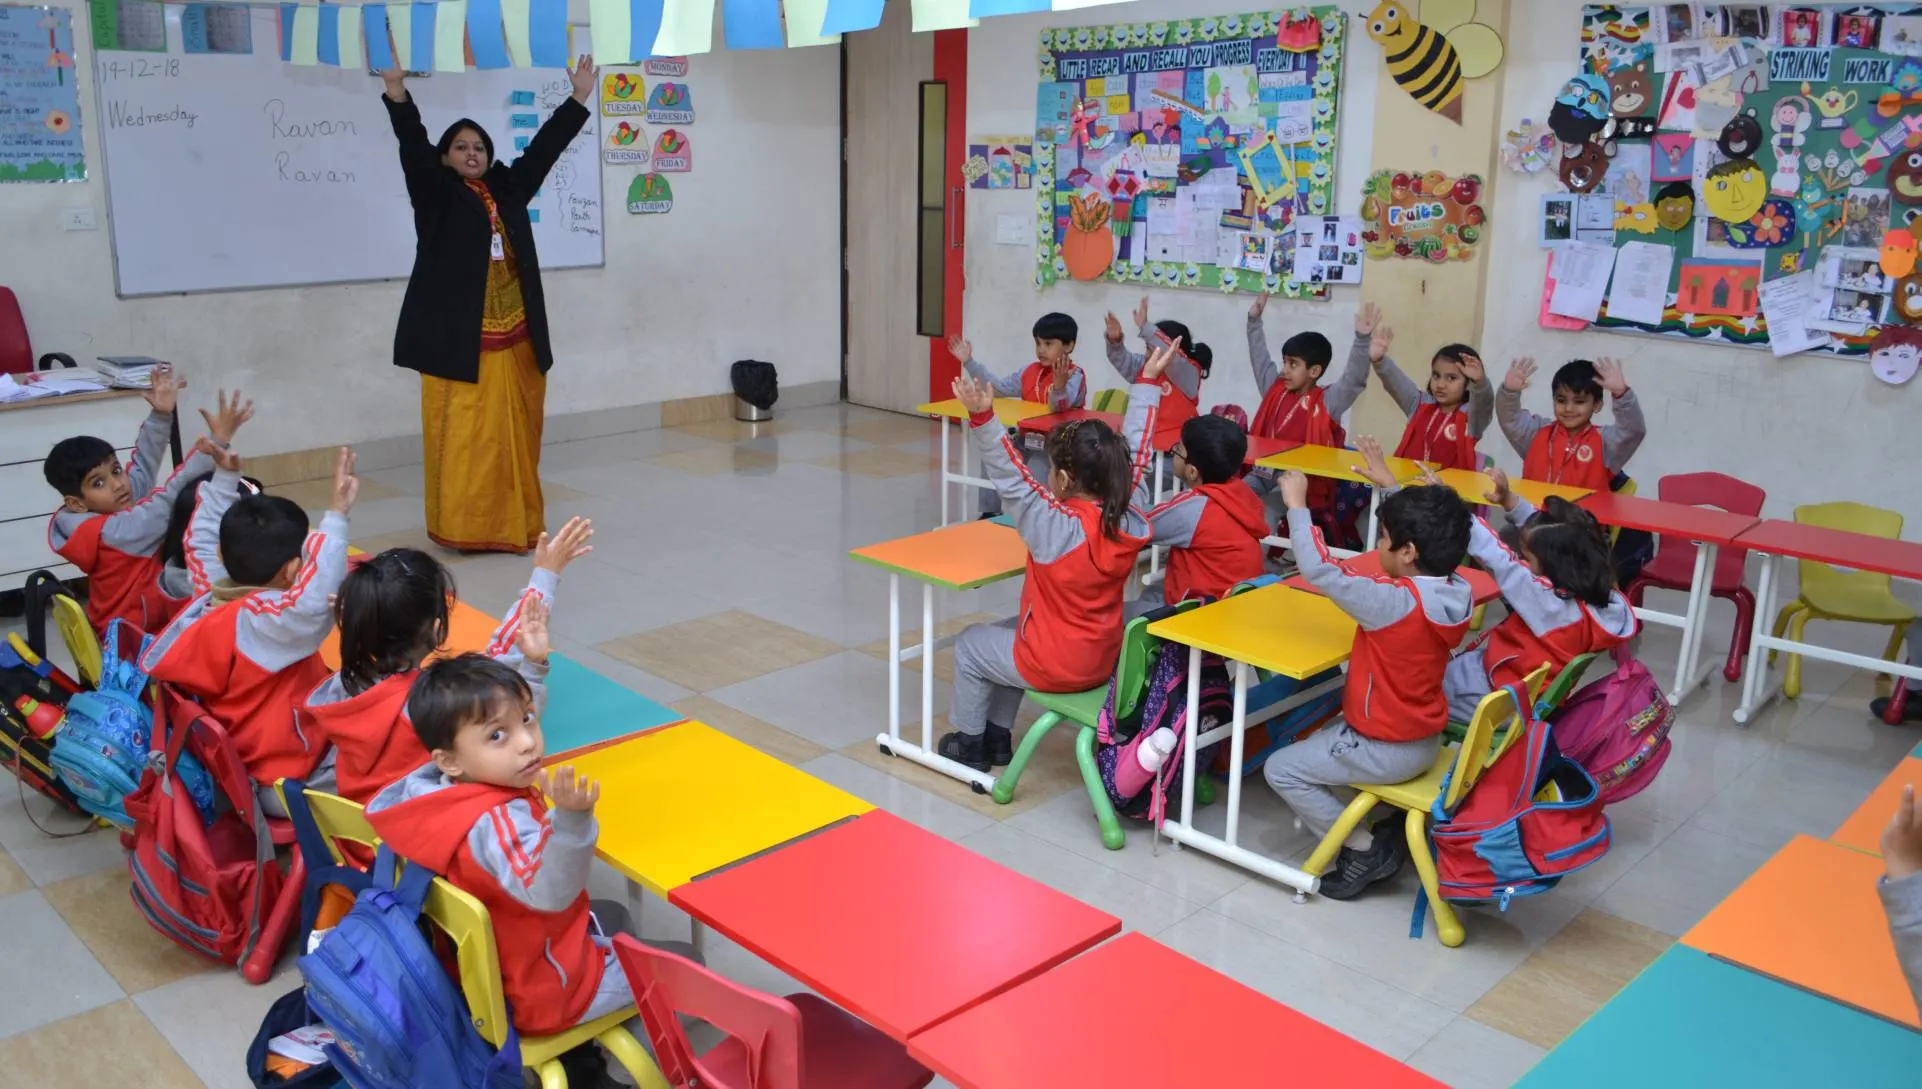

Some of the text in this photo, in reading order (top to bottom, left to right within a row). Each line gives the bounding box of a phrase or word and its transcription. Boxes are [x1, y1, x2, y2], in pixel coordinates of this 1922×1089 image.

[650, 62, 684, 73] MONDAY
[1060, 60, 1086, 80] LITTLE
[1091, 58, 1118, 77] RECAP
[1125, 53, 1148, 71] AND
[1152, 49, 1187, 68] RECALL
[1191, 47, 1211, 67] YOU
[1214, 42, 1250, 66] PROGRESS
[1771, 50, 1890, 82] STRIKING WORK
[108, 100, 199, 129] Wednesday
[606, 103, 643, 113] TUESDAY
[263, 98, 358, 139] Ravan
[647, 111, 694, 122] WEDNESDAY
[606, 151, 648, 161] THURSDAY
[656, 159, 686, 168] FRIDAY
[274, 151, 356, 182] Ravan
[629, 202, 671, 212] SATURDAY
[1390, 203, 1445, 225] Fruits
